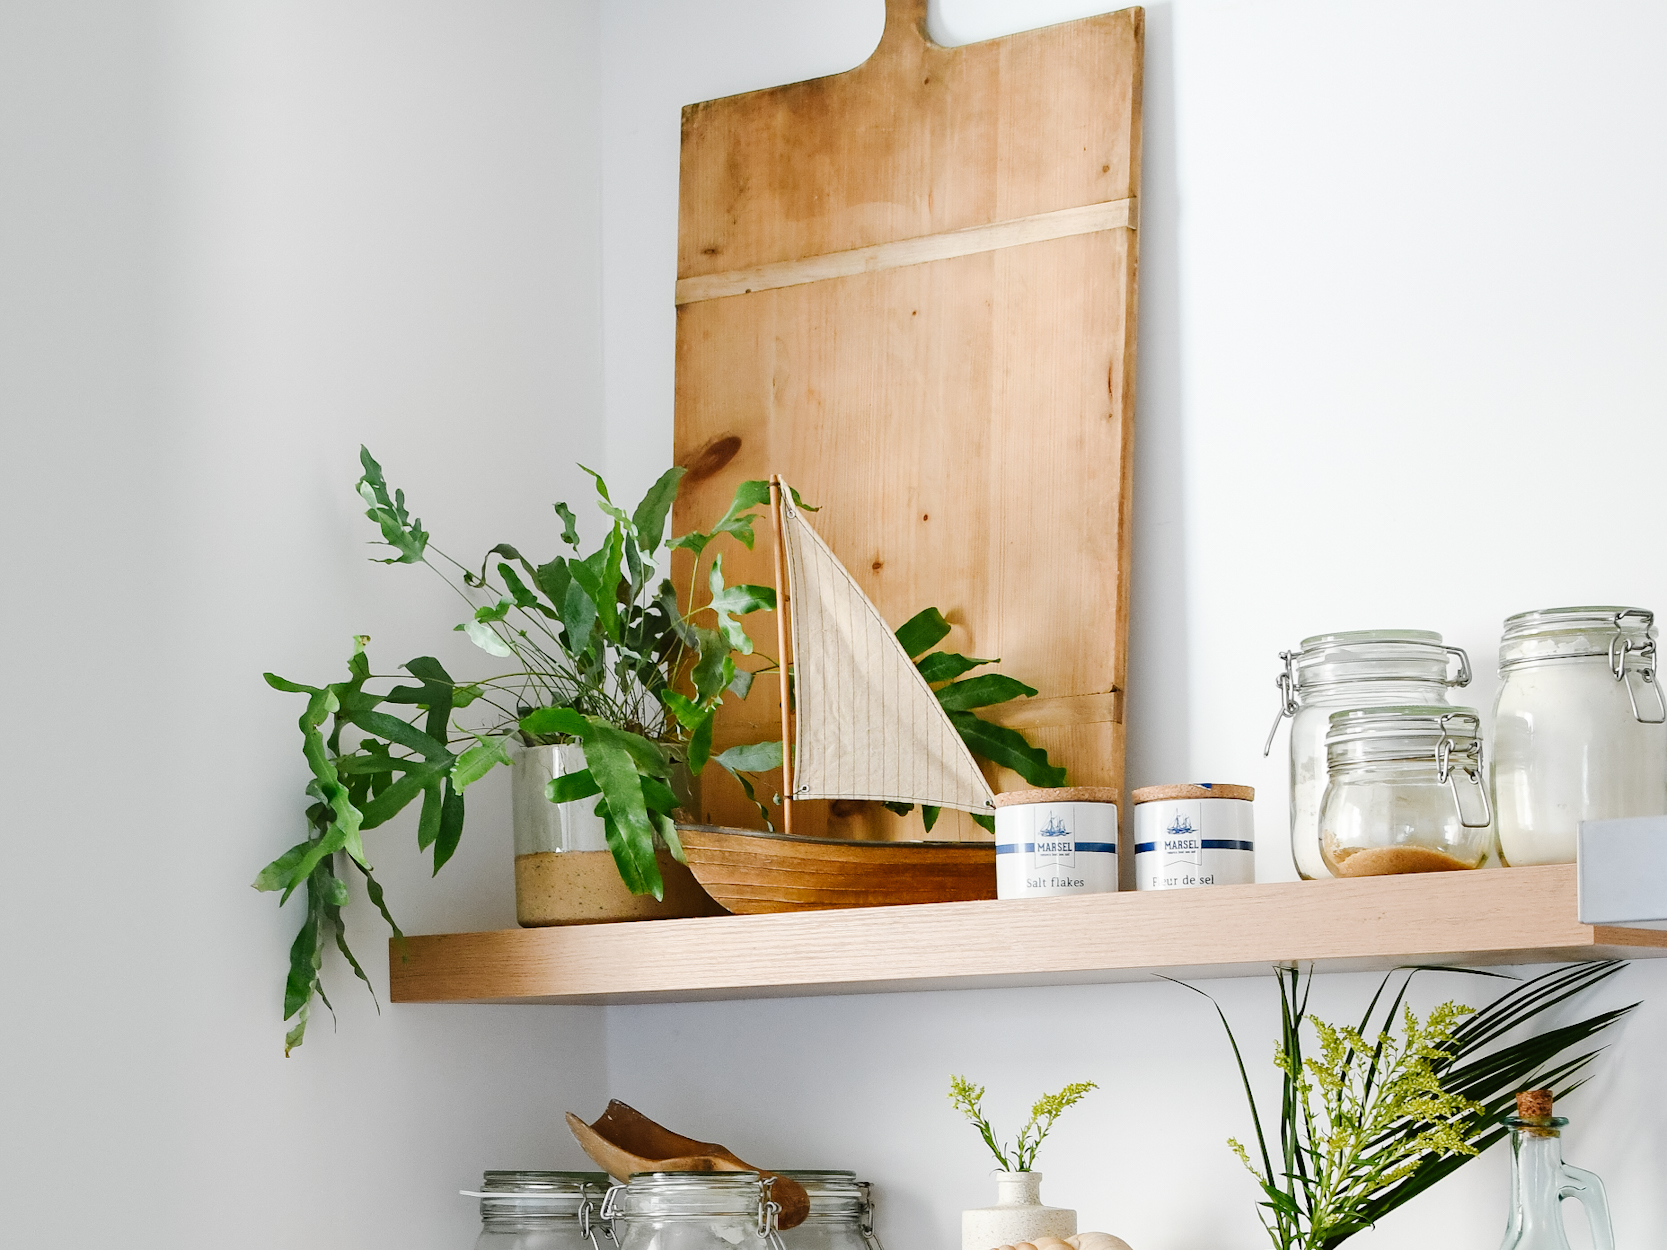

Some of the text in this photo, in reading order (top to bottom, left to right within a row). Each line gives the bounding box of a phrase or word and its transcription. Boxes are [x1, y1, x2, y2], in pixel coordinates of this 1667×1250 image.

[1037, 842, 1073, 852] MARSEL
[1164, 839, 1199, 850] MARSEL
[1026, 876, 1085, 888] Salt flakes
[1182, 874, 1196, 885] de
[1199, 873, 1214, 885] sel
